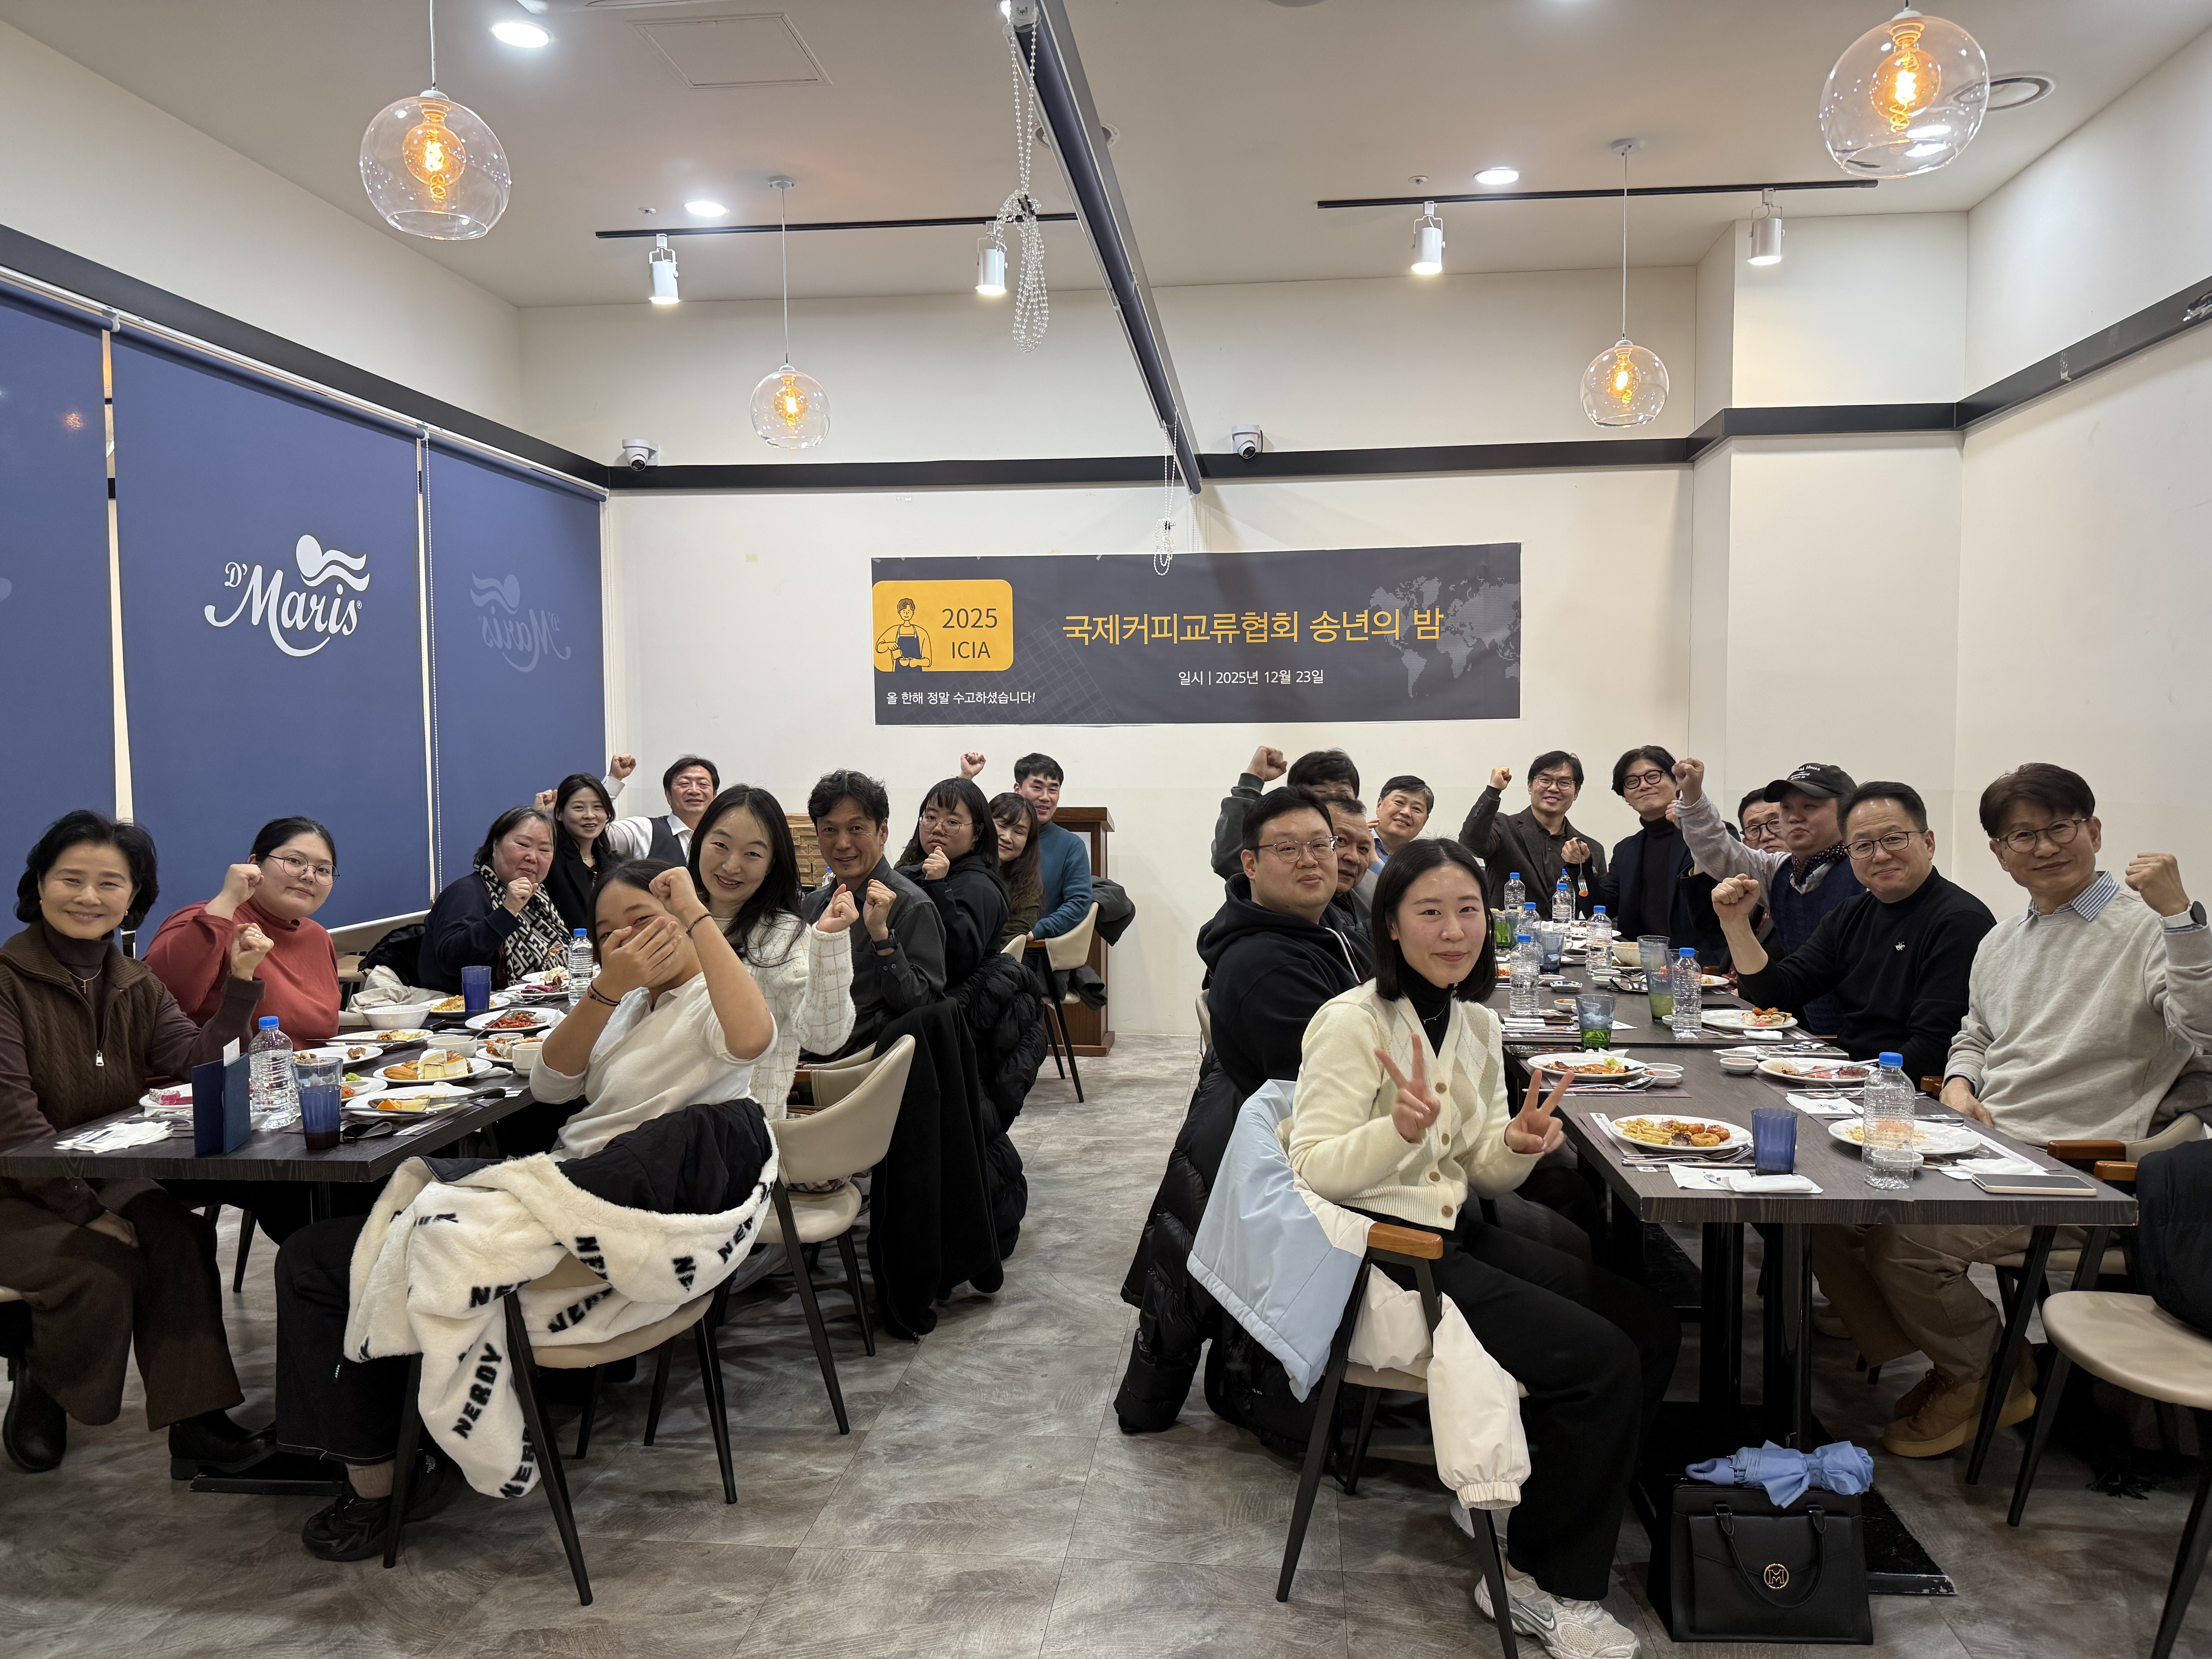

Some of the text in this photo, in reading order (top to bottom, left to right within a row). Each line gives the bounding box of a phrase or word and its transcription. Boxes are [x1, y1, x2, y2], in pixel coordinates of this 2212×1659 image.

[942, 608, 998, 629] 2025
[1063, 607, 1444, 646] 국제커피교류협회 송년의 밤
[952, 641, 991, 659] ICIA
[1178, 671, 1203, 685] 일시
[1216, 670, 1258, 685] 2025년
[1264, 670, 1291, 684] 12월
[1296, 669, 1324, 684] 23일
[886, 691, 1036, 704] 올 한해 정말 수고하셨습니다!
[452, 1343, 502, 1439] NERDY
